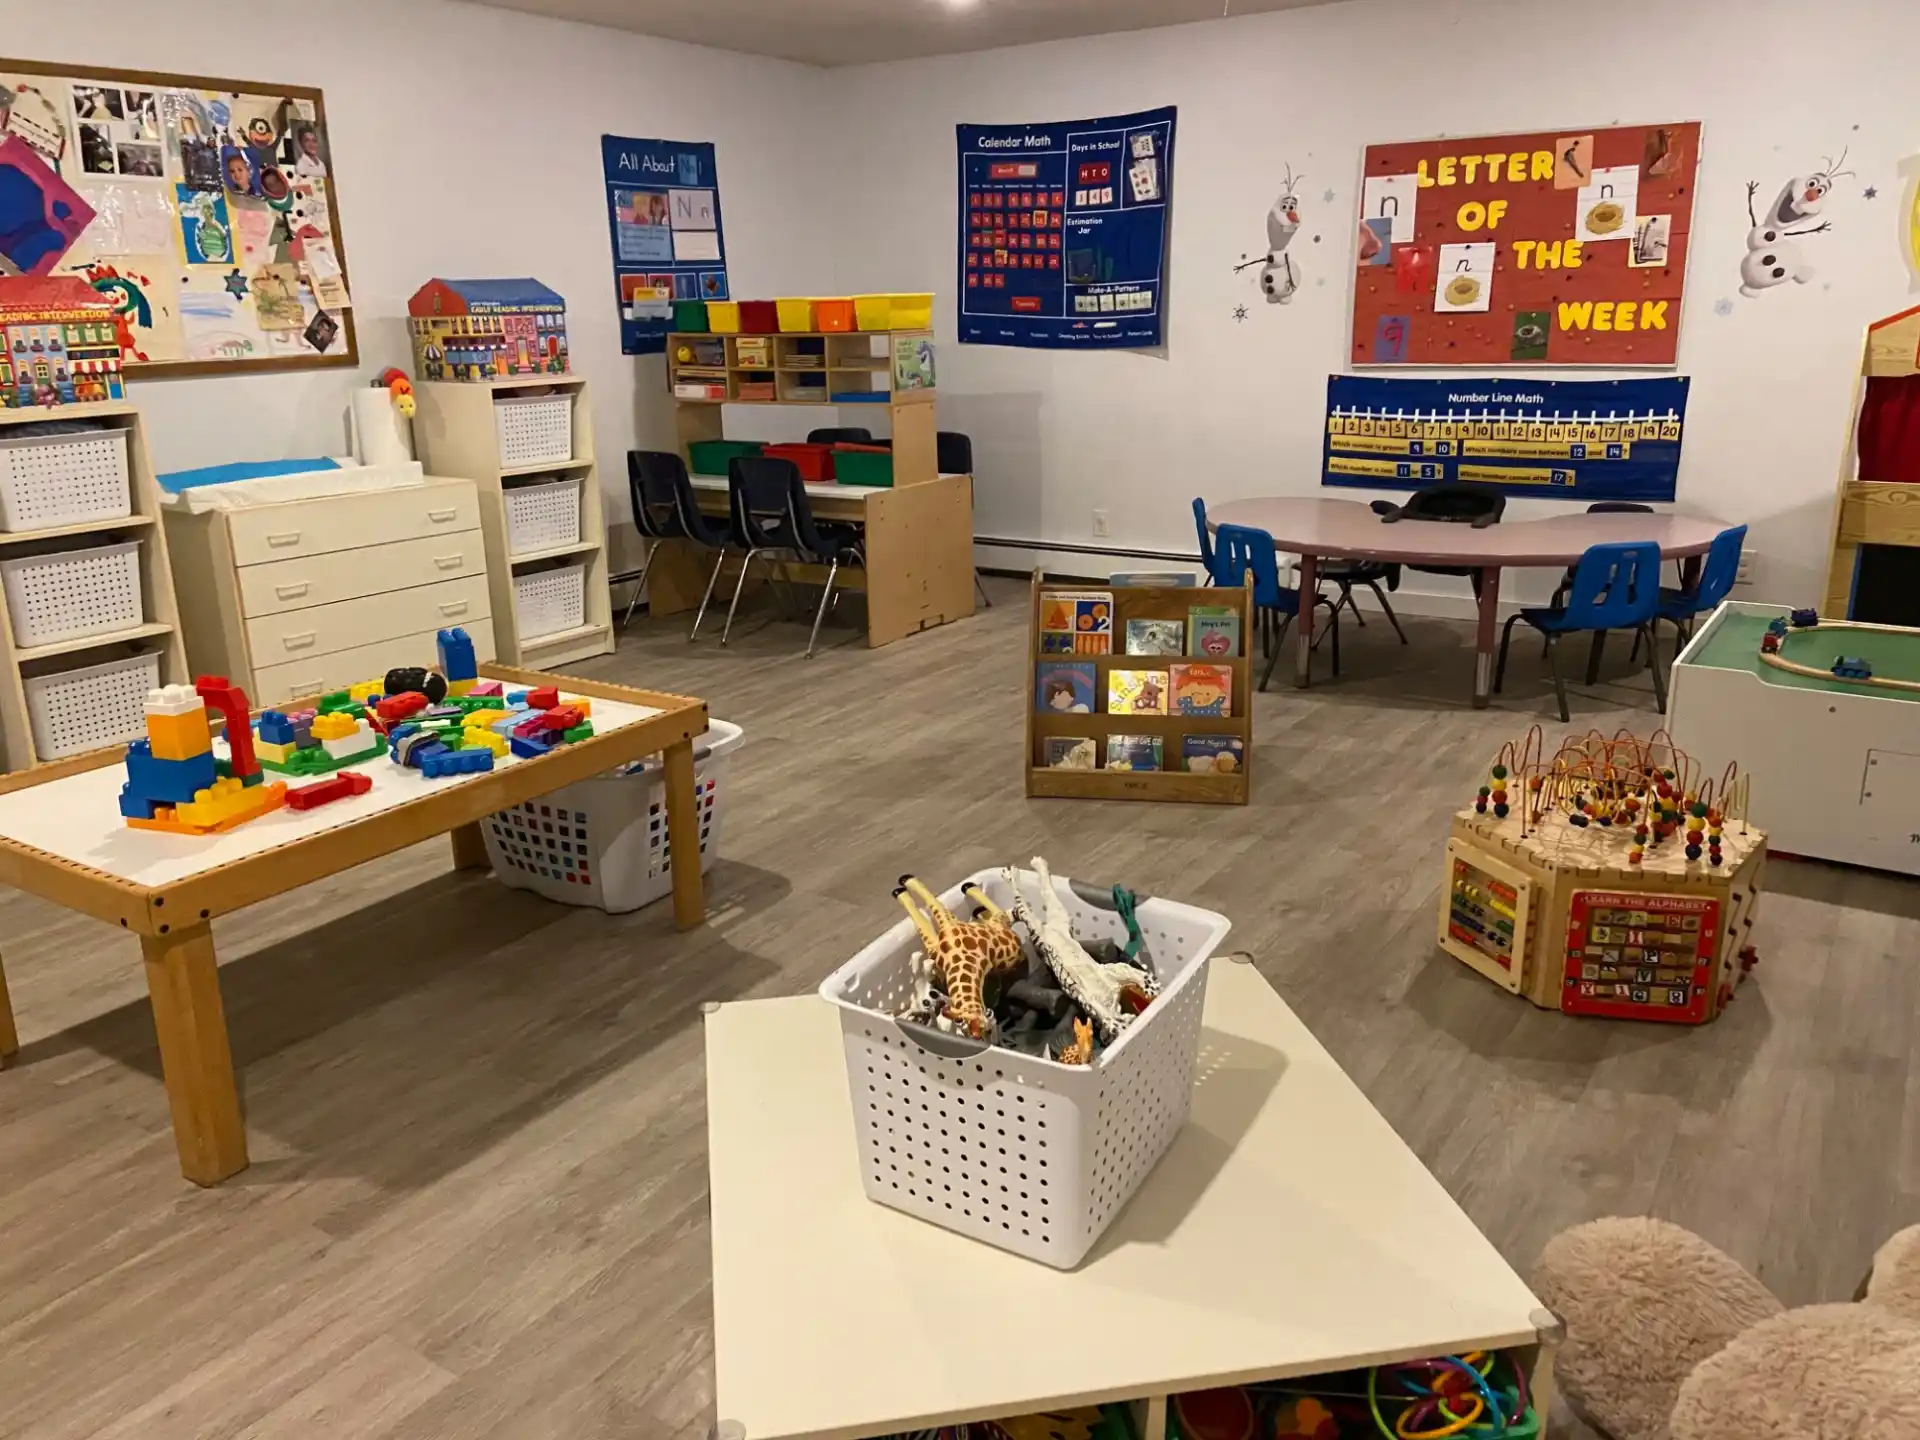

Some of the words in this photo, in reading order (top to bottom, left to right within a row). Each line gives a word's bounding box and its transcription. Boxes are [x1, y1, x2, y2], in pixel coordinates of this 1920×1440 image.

[978, 136, 1022, 148] Calendar
[1024, 134, 1051, 147] Math
[1072, 144, 1088, 152] Days
[1089, 142, 1096, 150] in
[1098, 140, 1120, 150] School
[618, 152, 638, 170] All
[642, 154, 676, 173] About
[1416, 151, 1554, 187] LETTER
[1081, 170, 1088, 178] H
[1092, 169, 1097, 177] T
[1600, 182, 1614, 198] n
[677, 195, 692, 219] N
[701, 206, 710, 218] n
[1380, 194, 1399, 217] n
[1067, 218, 1103, 226] Estimation
[1456, 200, 1508, 231] OF
[1513, 240, 1584, 269] THE
[1455, 257, 1472, 272] n
[1087, 285, 1140, 294] Make-A-Pattern
[39, 310, 111, 320] INTERVENTION
[1557, 301, 1668, 331] WEEK
[1448, 393, 1489, 403] Number
[1491, 393, 1512, 403] Line
[1515, 393, 1544, 404] Math
[1333, 422, 1338, 430] 1
[1348, 421, 1355, 431] 2
[1364, 422, 1371, 432] 3
[1379, 423, 1386, 433] 4
[1394, 423, 1401, 432] 5
[1411, 424, 1418, 434] 6
[1428, 426, 1435, 435] 7
[1445, 426, 1452, 435] 8
[1462, 425, 1469, 435] 9
[1476, 426, 1488, 436] 10
[1496, 426, 1505, 436] 11
[1513, 426, 1523, 436] 12
[1531, 427, 1541, 437] 13
[1550, 427, 1560, 437] 14
[1567, 427, 1578, 437] 15
[1585, 429, 1596, 439] 16
[1604, 427, 1616, 437] 17
[1623, 428, 1635, 438] 18
[1643, 426, 1655, 436] 19
[1662, 426, 1678, 436] 20
[1332, 440, 1350, 448] Which
[1413, 444, 1420, 453] 9
[1438, 444, 1448, 453] 10
[1538, 448, 1569, 456] between
[1573, 447, 1583, 457] 12
[1608, 447, 1620, 457] 14
[1400, 467, 1408, 475] 11
[1425, 468, 1431, 476] 5
[1553, 472, 1564, 482] 17
[1097, 615, 1110, 632] 2
[1584, 896, 1620, 905] LEARN
[1624, 898, 1645, 906] THE
[1648, 899, 1707, 909] ALPHABET
